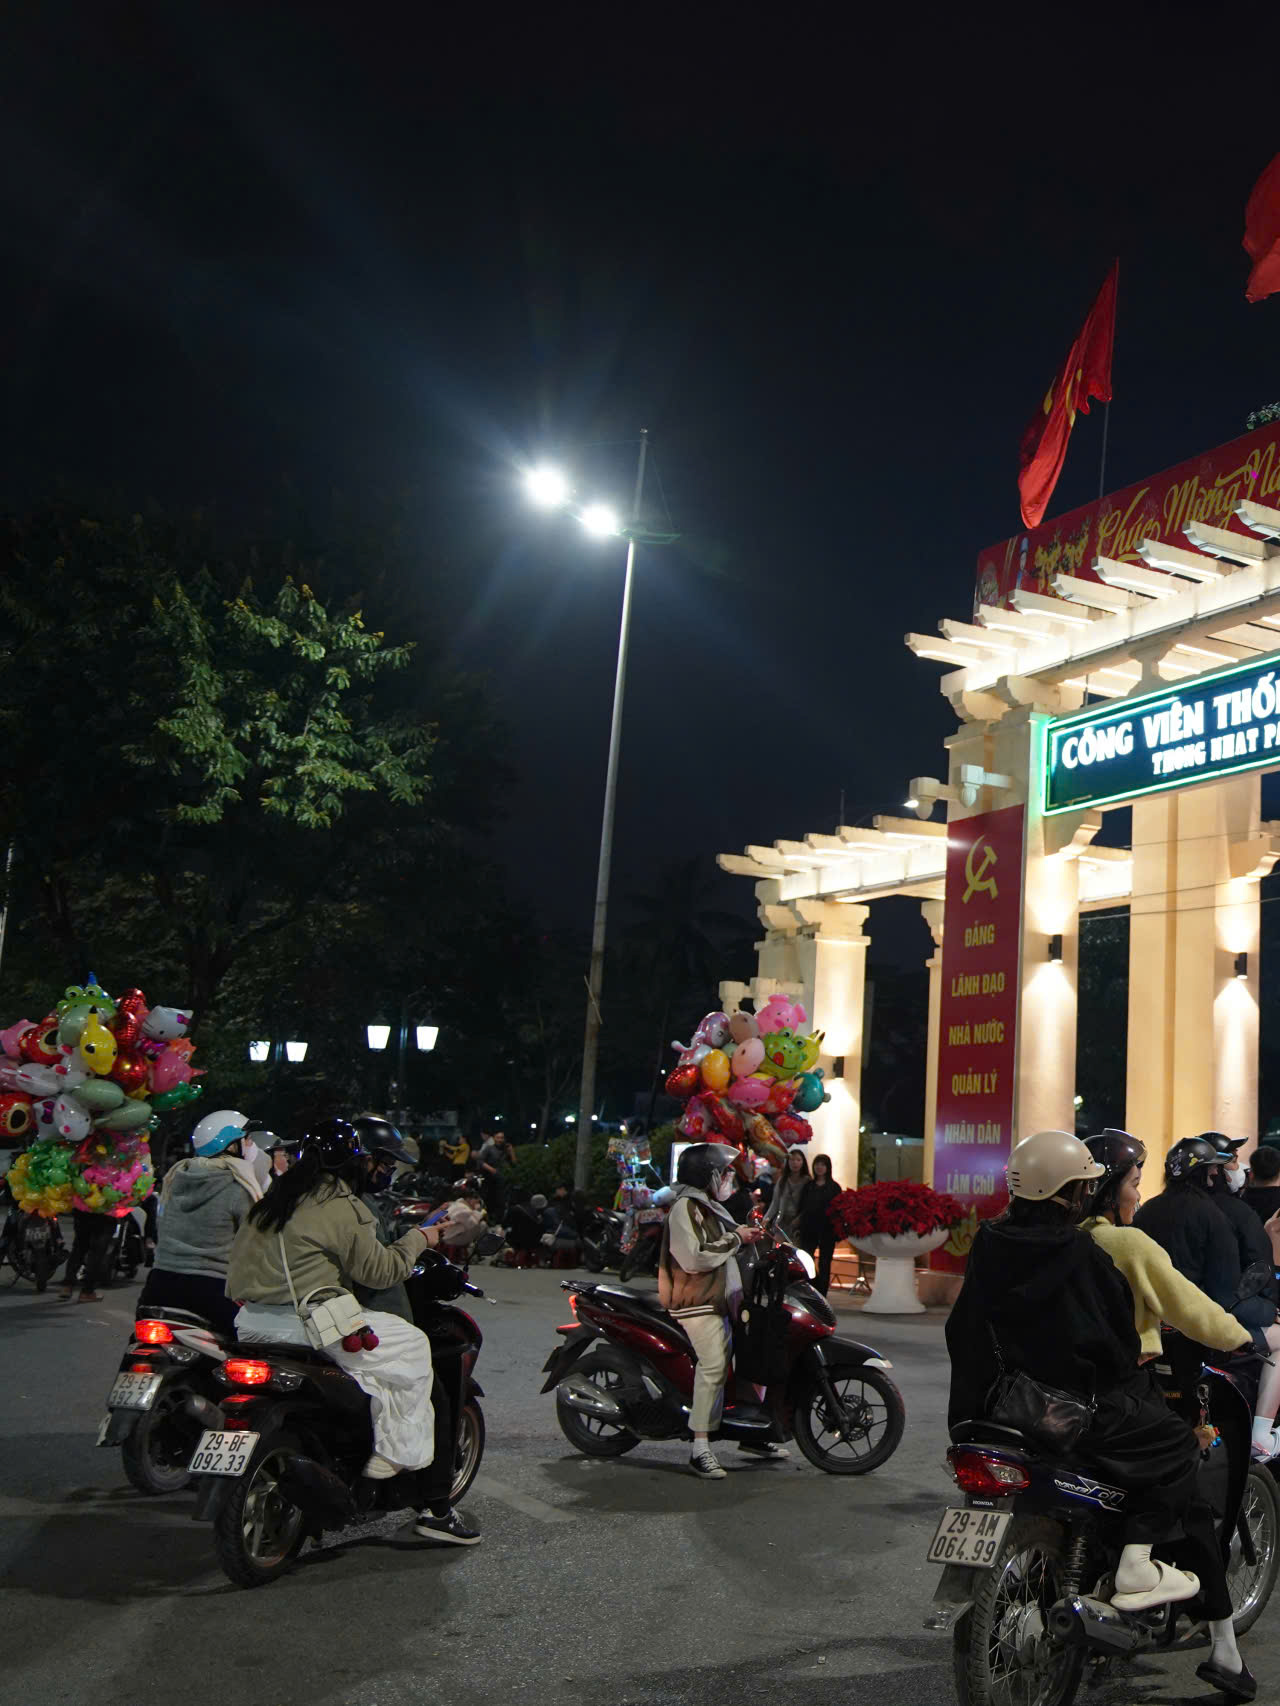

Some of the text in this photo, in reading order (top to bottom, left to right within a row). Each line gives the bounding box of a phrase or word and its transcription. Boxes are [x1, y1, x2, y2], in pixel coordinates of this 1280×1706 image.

[1061, 721, 1134, 769] CÔNG
[1142, 700, 1205, 748] VIÊN
[964, 920, 996, 948] ĐẢNG
[948, 1018, 1005, 1047] NHÀ NƯỚC
[952, 1067, 998, 1097] QUẢN LÝ
[944, 1119, 1001, 1145] NHÂN DÂN
[204, 1433, 249, 1452] 29-BF
[192, 1452, 246, 1472] 092.33
[946, 1511, 1001, 1538] 29-AM
[933, 1536, 997, 1563] 064.99
